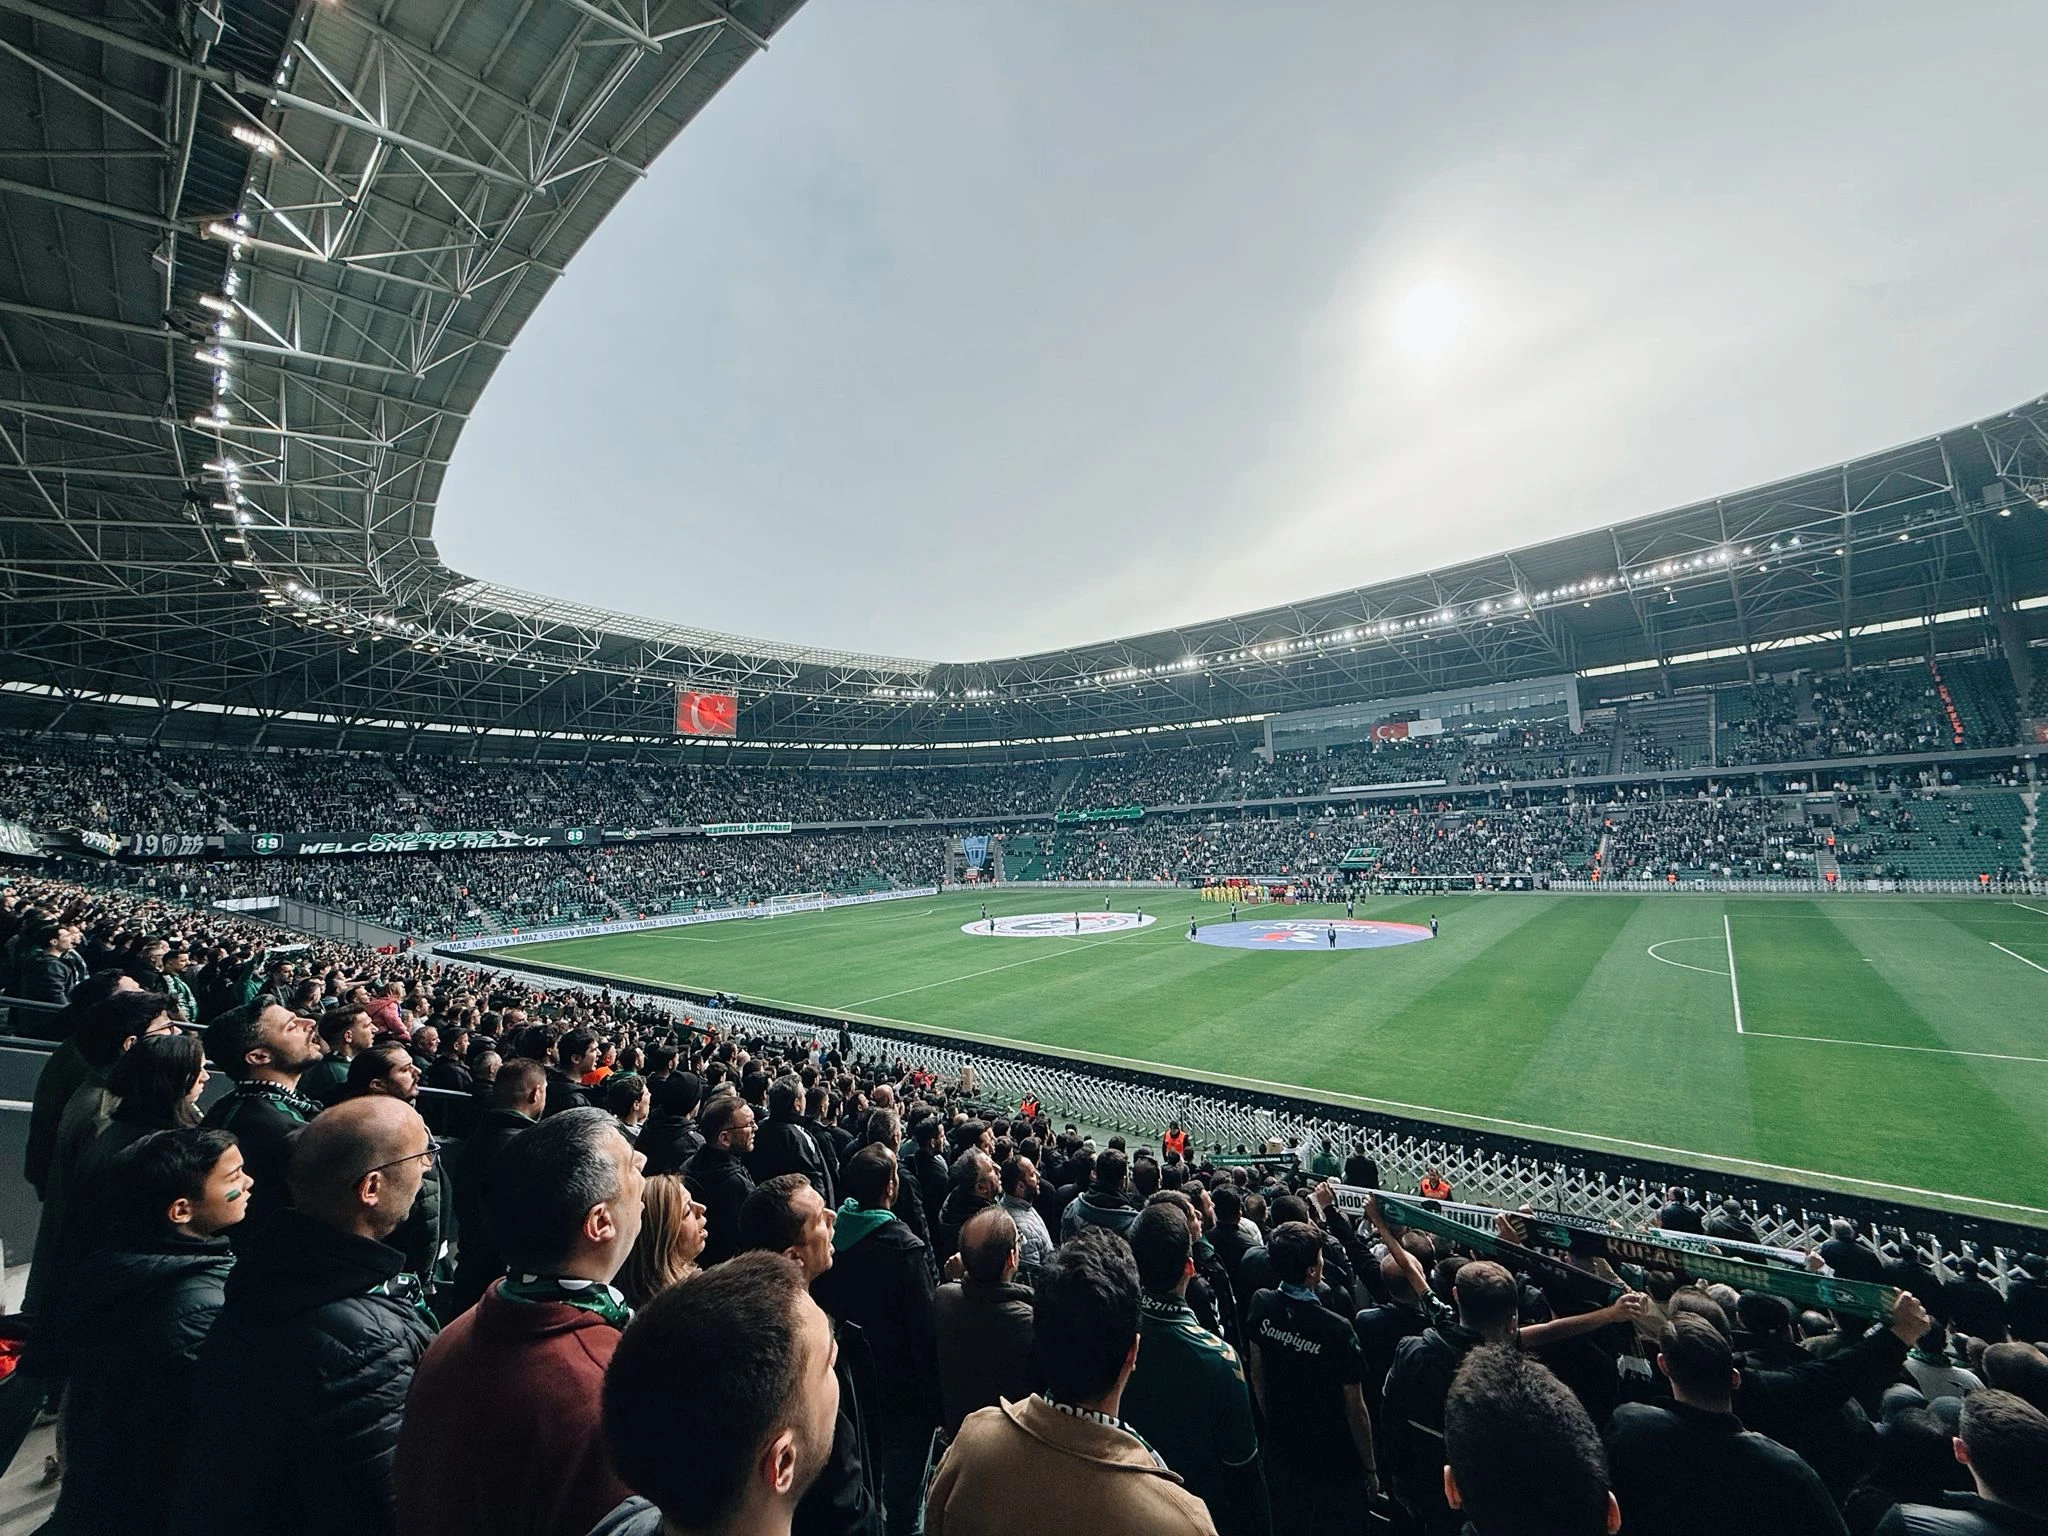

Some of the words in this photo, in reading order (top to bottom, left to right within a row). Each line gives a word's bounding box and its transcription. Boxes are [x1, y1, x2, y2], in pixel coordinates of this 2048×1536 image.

[257, 837, 279, 849] 89
[568, 830, 583, 841] 89
[299, 842, 419, 854] WELCOME
[428, 840, 457, 851] TO
[463, 838, 519, 849] HELL
[524, 836, 551, 847] OF
[472, 938, 503, 948] NISSAN
[511, 934, 538, 943] YILMAZ
[541, 930, 569, 940] NISSAN
[577, 927, 600, 936] YILMAZ
[604, 924, 629, 933] NISSAN
[635, 920, 657, 929] YILMAZ
[659, 917, 682, 926] NISSAN
[687, 914, 708, 922] YILMAZ
[710, 911, 732, 920] NISSAN
[737, 909, 754, 917] YILMAZ
[1259, 1318, 1321, 1354] Sampiyon
